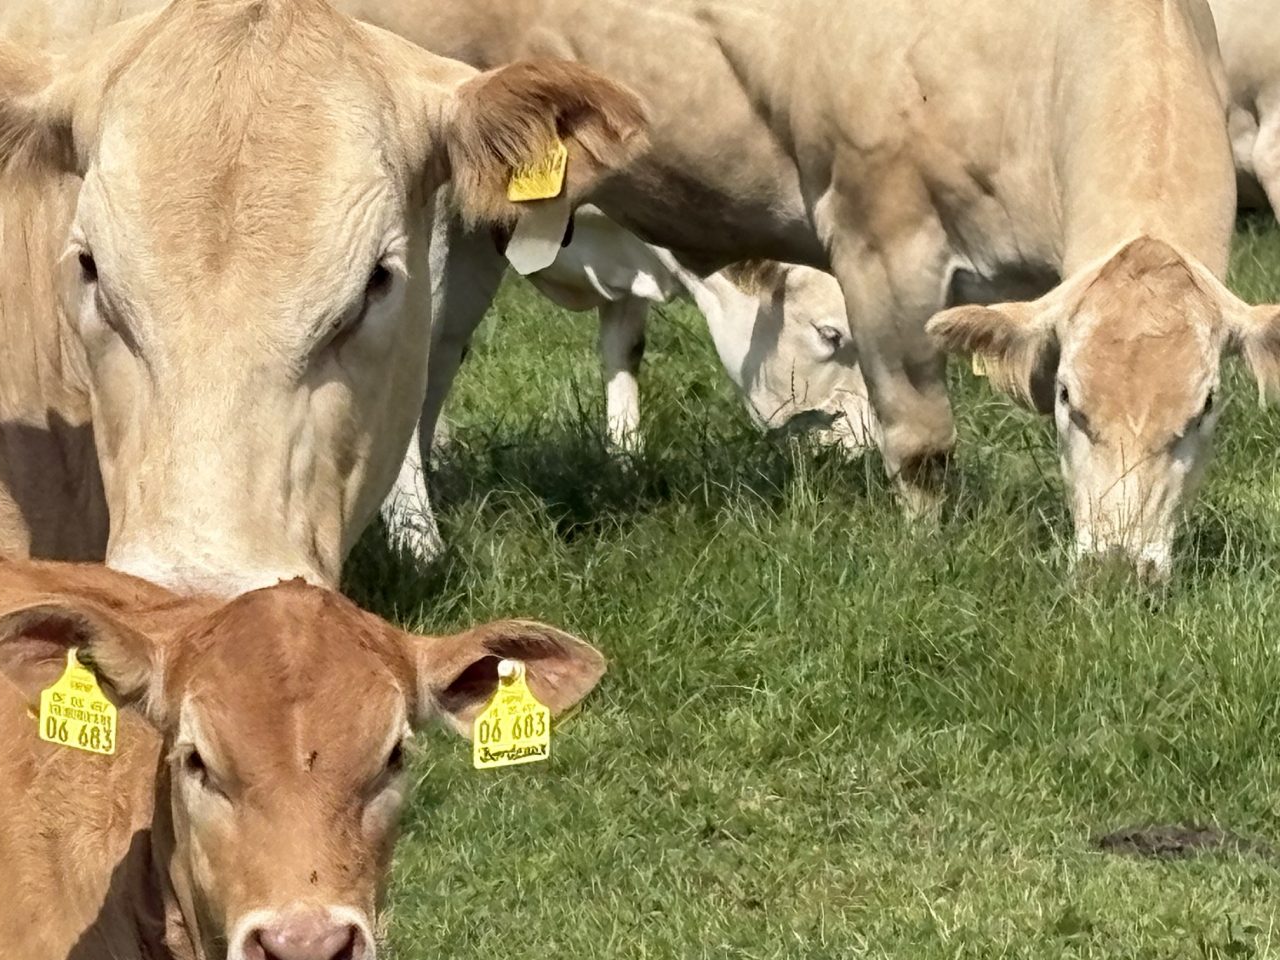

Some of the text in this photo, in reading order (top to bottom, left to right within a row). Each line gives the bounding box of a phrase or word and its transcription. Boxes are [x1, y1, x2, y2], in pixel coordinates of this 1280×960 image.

[46, 716, 113, 752] 06 683
[479, 718, 501, 744] 06
